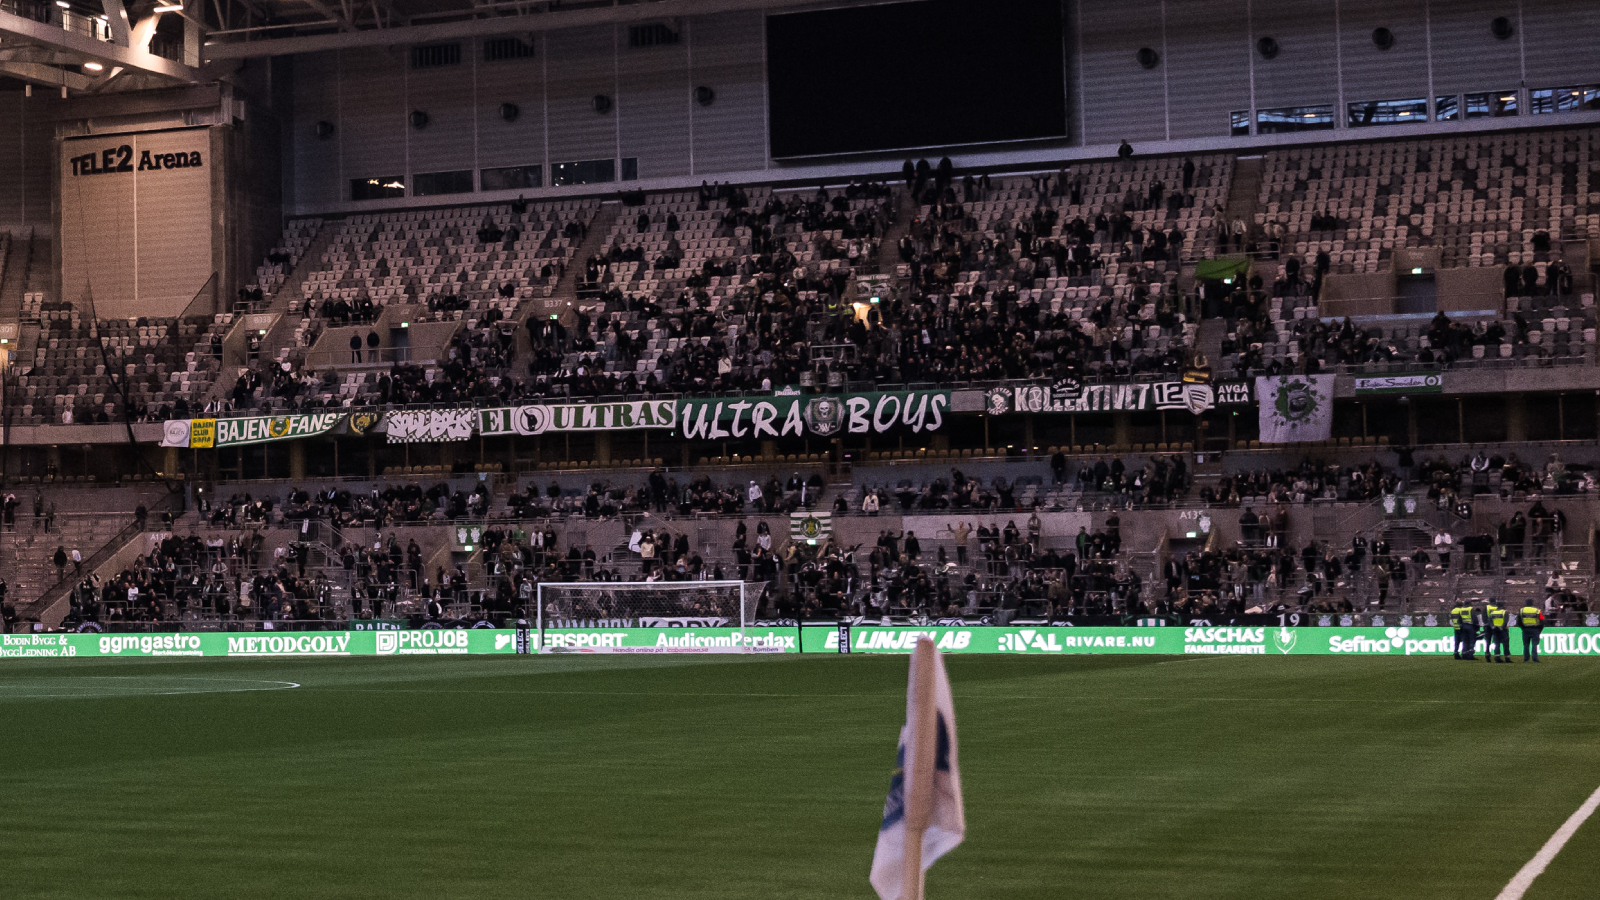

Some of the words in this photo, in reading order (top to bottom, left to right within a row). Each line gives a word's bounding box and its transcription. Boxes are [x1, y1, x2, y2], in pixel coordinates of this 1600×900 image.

[71, 145, 133, 176] TELE2
[138, 151, 202, 171] Arena
[1218, 383, 1249, 394] AVGÅ
[1218, 393, 1249, 403] ALLA
[552, 402, 675, 429] ULTRAS
[682, 399, 803, 440] ULTRA
[846, 392, 947, 434] BOYS
[218, 418, 273, 443] BAJEN
[286, 413, 337, 435] FANS
[58, 634, 68, 645] &
[99, 633, 201, 653] ggmgastro
[227, 635, 350, 652] METODGOLV
[399, 630, 468, 648] PROJOB
[511, 633, 625, 649] ITERSPORT
[824, 631, 852, 649] E
[937, 631, 972, 649] AB
[838, 626, 848, 653] SELECT
[998, 629, 1062, 651] RIVAL
[1066, 636, 1155, 647] RIVARE.NU
[1184, 628, 1265, 643] SASCHAS
[1329, 635, 1390, 653] Sefina
[60, 646, 76, 657] AB
[1184, 645, 1265, 654] FAMILJEARBETE
